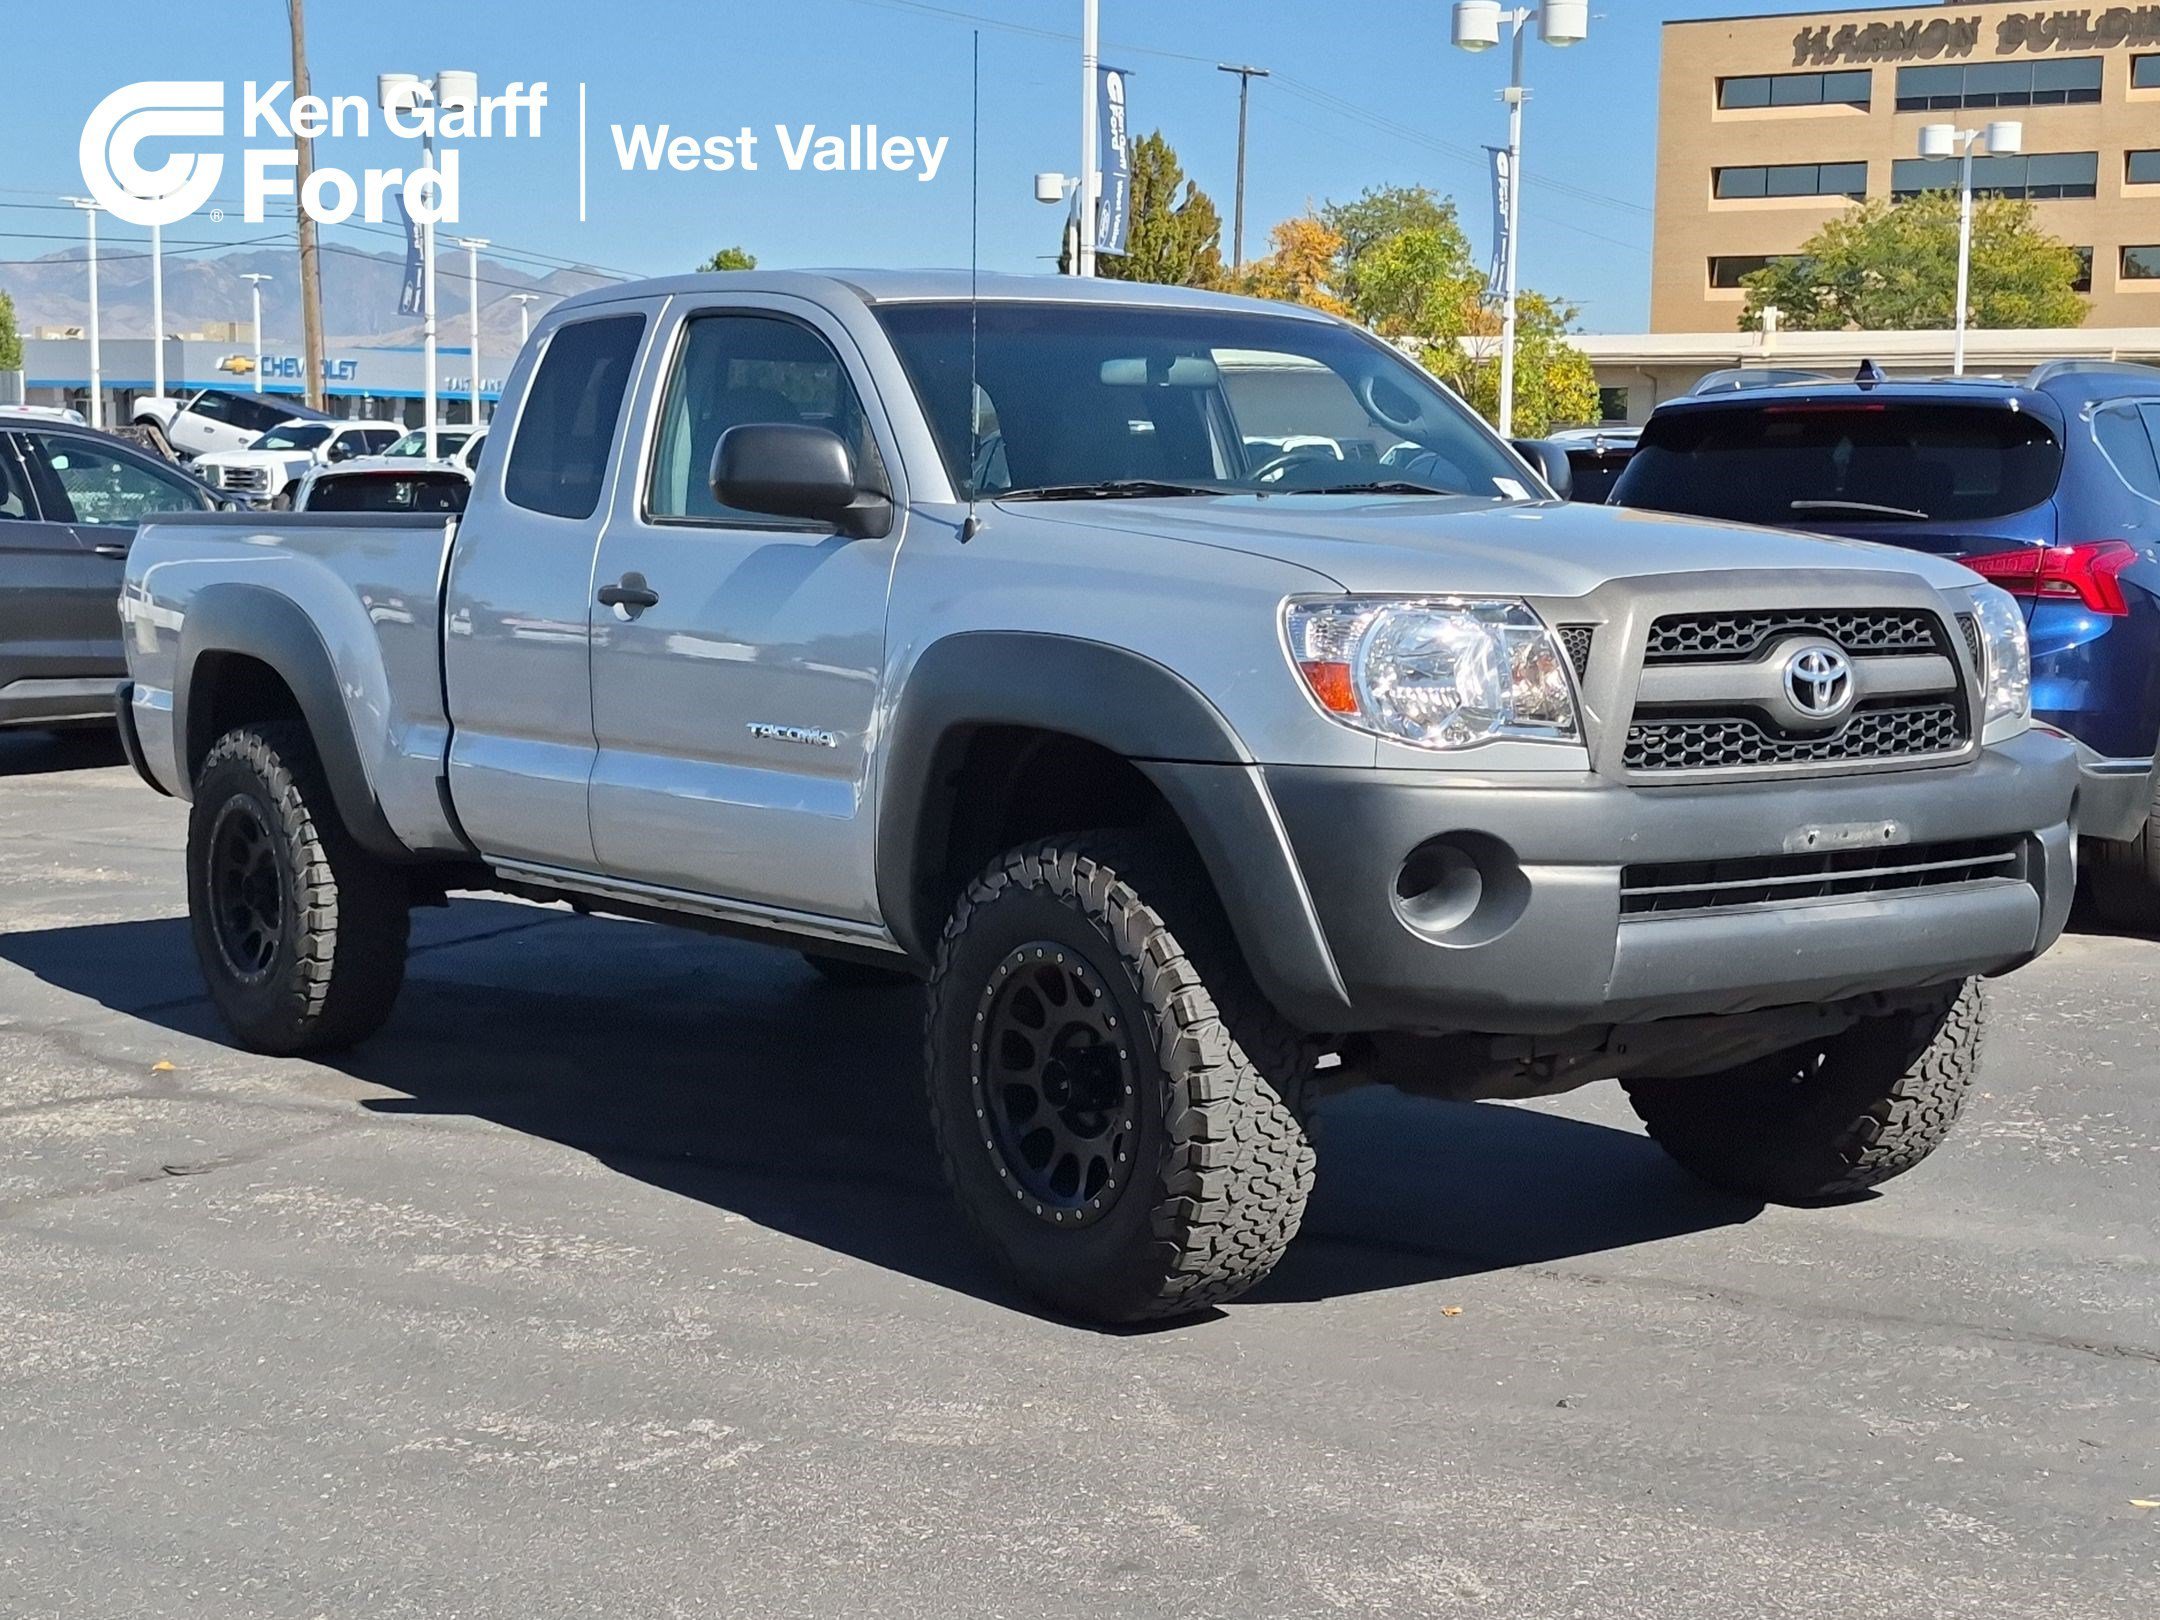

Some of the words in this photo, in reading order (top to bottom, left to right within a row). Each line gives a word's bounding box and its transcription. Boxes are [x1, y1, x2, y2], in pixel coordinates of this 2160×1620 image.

[1792, 16, 1982, 66] HARMON
[261, 356, 358, 381] CHEVOLET
[746, 722, 838, 749] TACOMA
